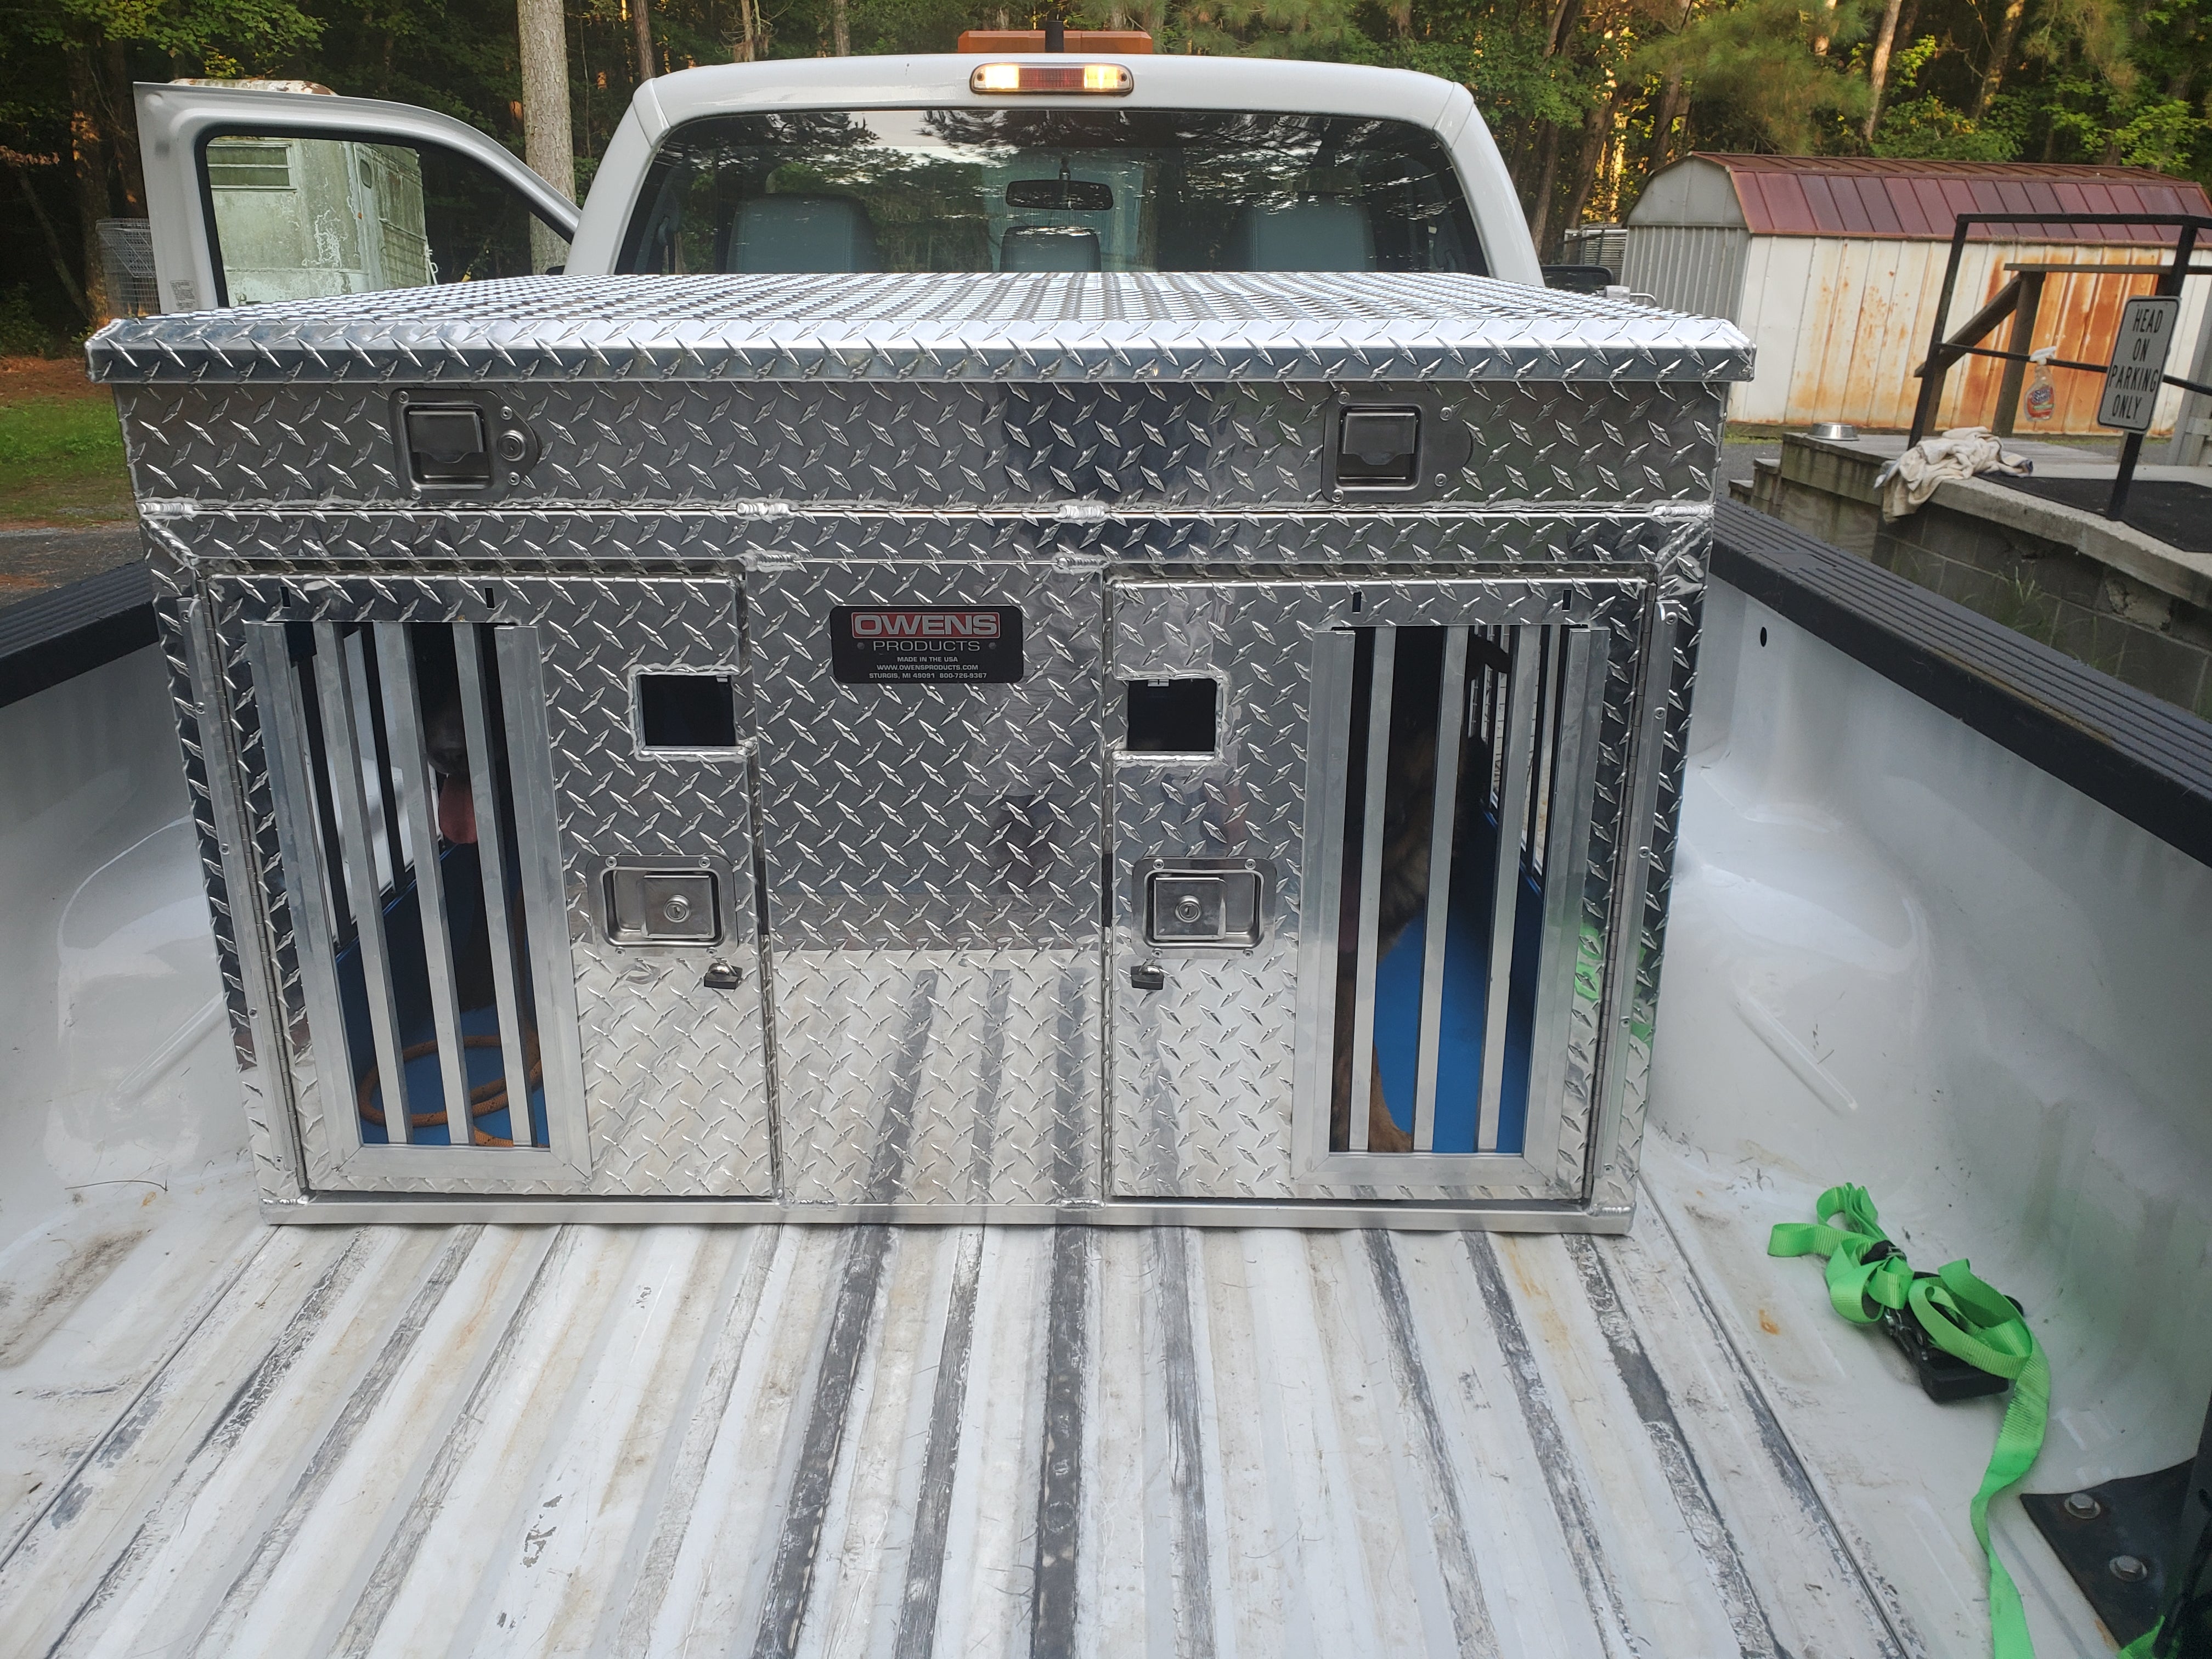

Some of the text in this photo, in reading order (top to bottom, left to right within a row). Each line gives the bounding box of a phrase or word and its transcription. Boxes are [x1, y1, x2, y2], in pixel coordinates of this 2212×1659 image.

[2132, 308, 2163, 334] HEAD
[2132, 338, 2151, 362] ON
[2108, 365, 2159, 393] PARKING
[2112, 394, 2143, 420] ONLY
[854, 614, 998, 636] OWENS
[873, 640, 981, 652] PRODUCTS
